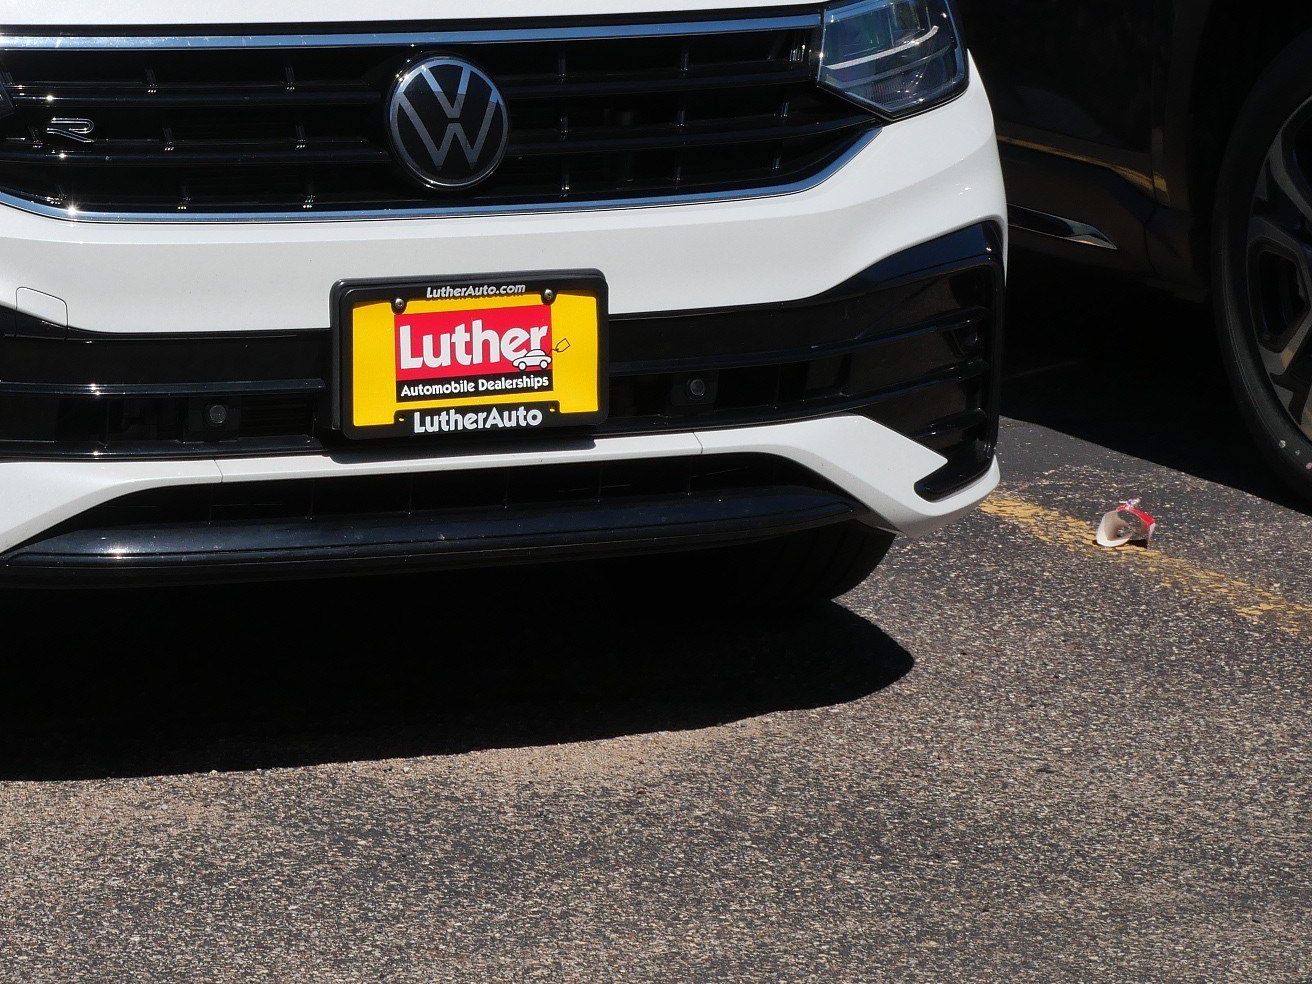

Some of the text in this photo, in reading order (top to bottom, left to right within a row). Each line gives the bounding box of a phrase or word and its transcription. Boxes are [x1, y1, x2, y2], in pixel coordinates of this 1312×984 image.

[426, 283, 526, 299] LutherAuto.com
[399, 319, 549, 370] Luther
[400, 374, 549, 397] Automobile Dealerships
[413, 405, 543, 434] LutherAuto
